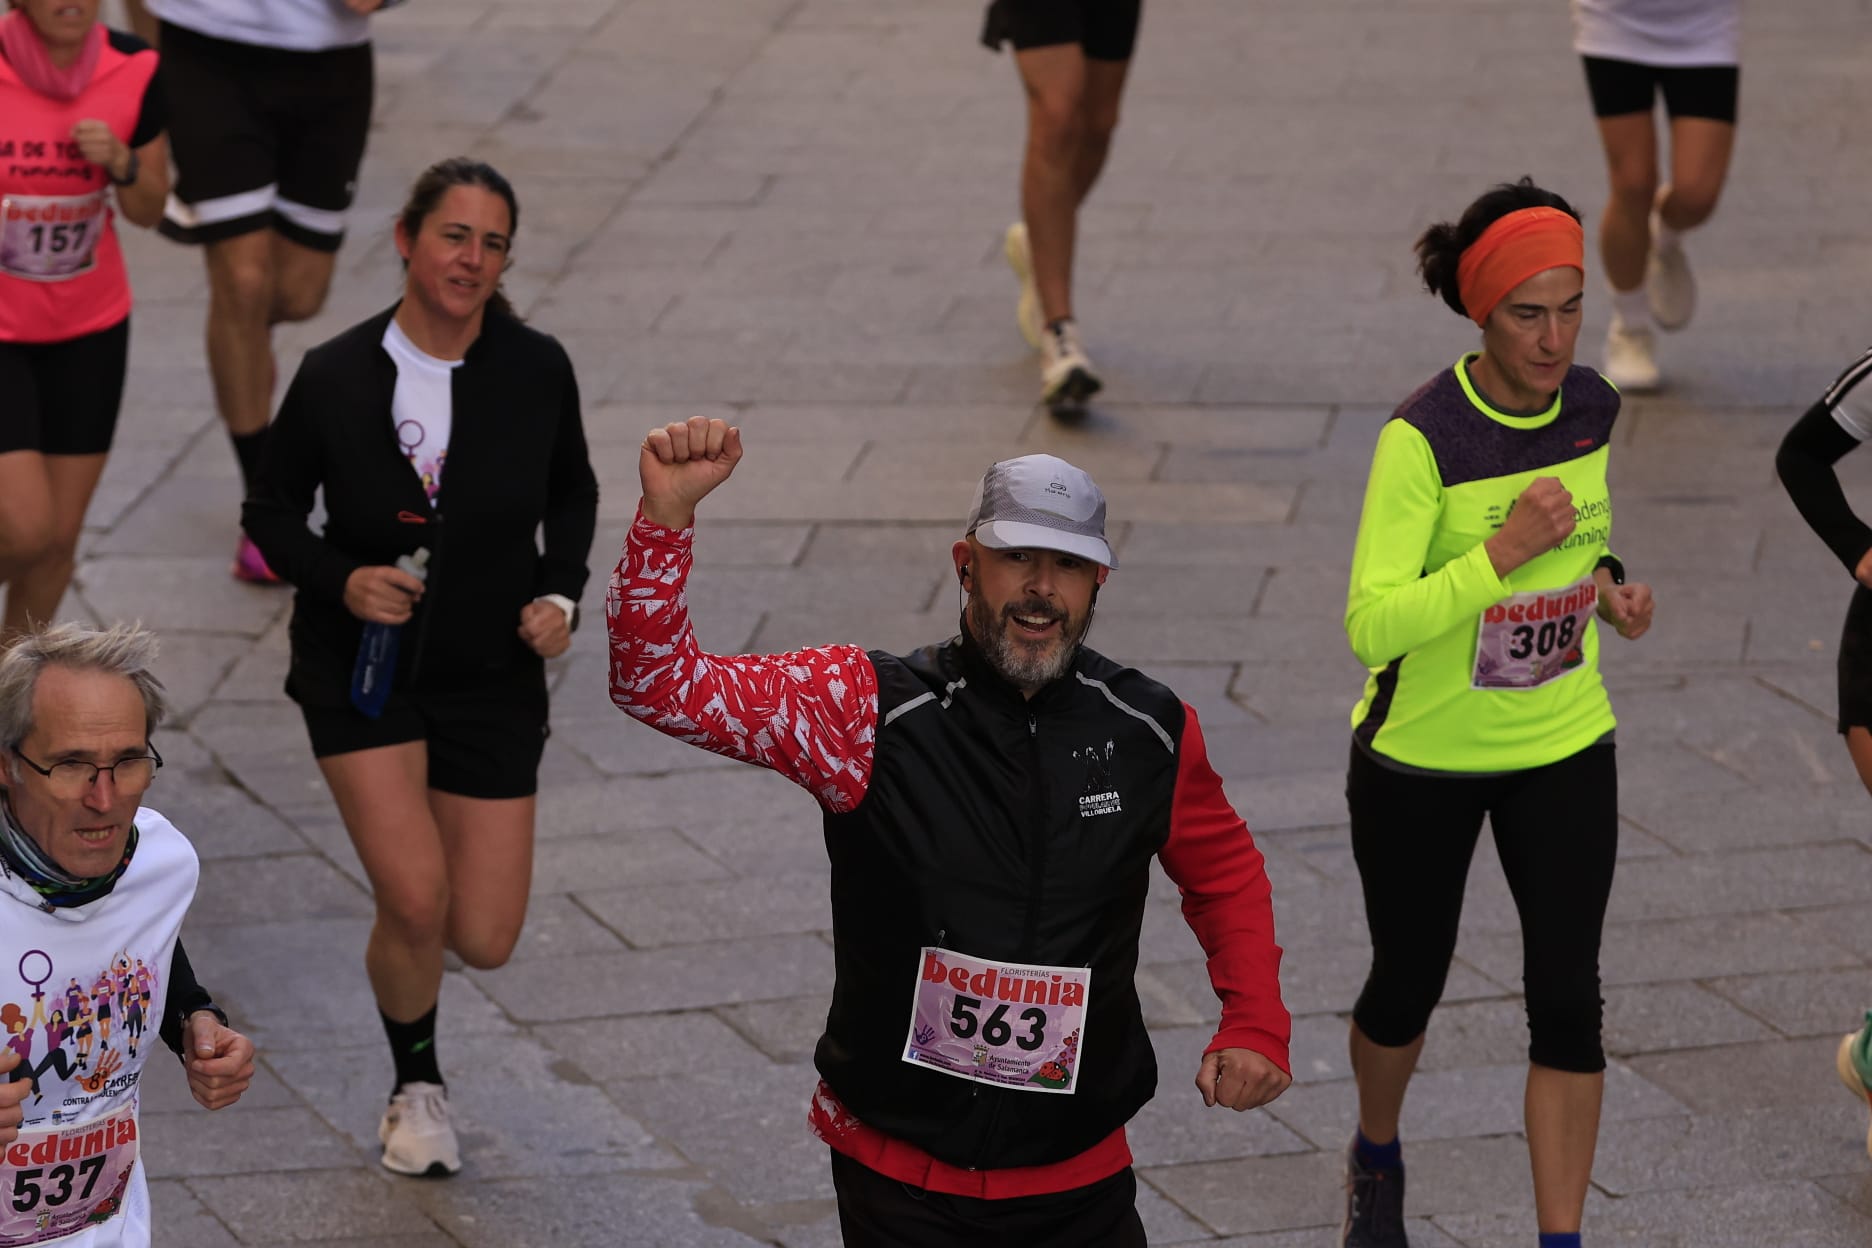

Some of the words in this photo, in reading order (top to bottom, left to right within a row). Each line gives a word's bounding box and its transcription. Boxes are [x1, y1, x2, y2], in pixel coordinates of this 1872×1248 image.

[31, 223, 88, 254] 157
[1510, 614, 1577, 660] 308
[1079, 791, 1119, 804] CARRERA
[922, 952, 1085, 1007] bedunia
[950, 994, 1047, 1051] 563
[988, 1062, 996, 1070] de
[996, 1063, 1029, 1075] Salamanca
[989, 1055, 1031, 1067] Ayuntamiento
[12, 1154, 107, 1213] 537
